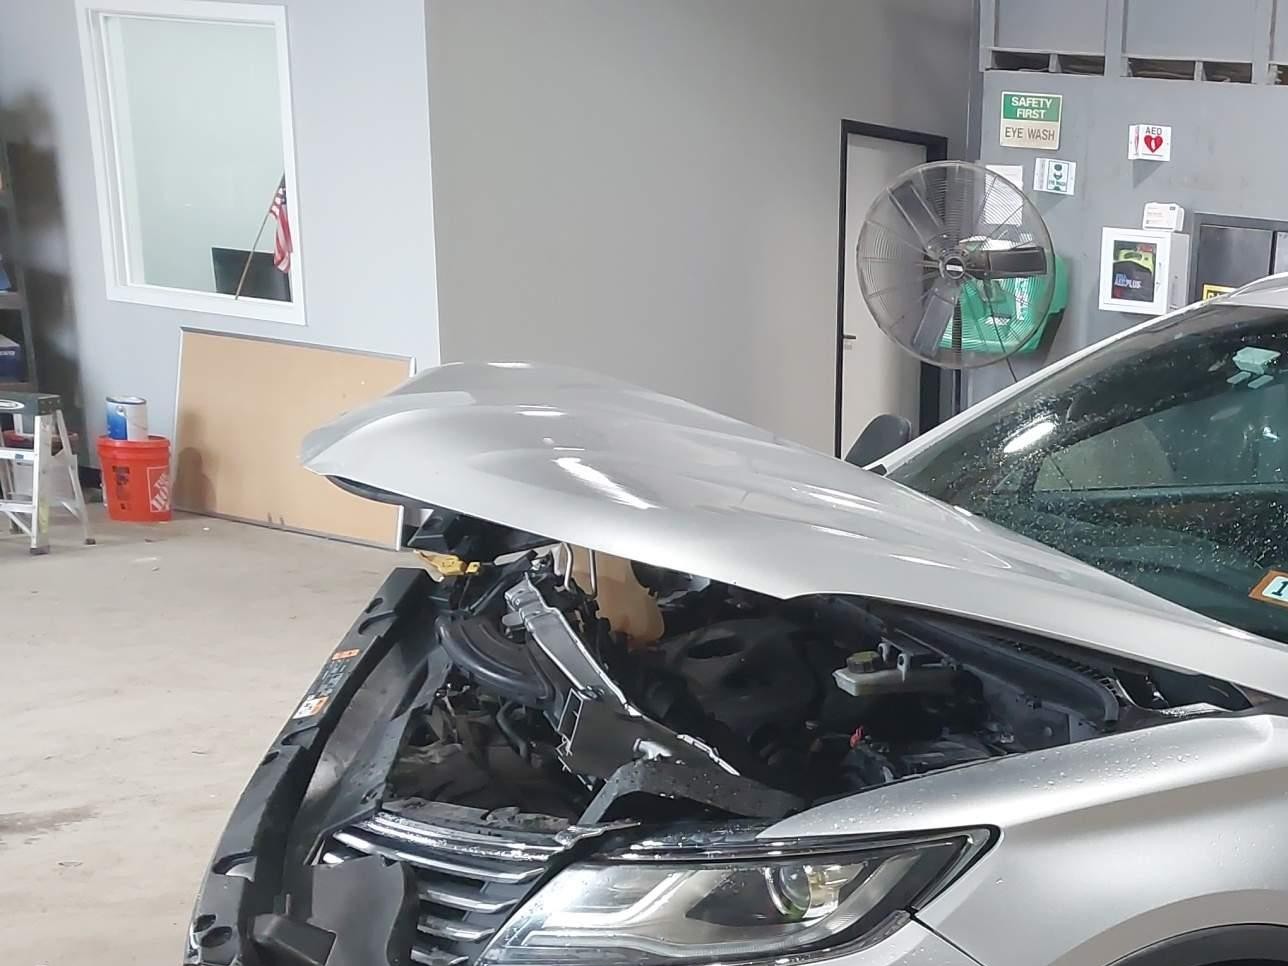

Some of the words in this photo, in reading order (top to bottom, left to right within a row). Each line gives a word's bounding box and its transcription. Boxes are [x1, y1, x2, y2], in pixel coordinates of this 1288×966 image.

[1011, 96, 1053, 108] SAFETY
[1016, 108, 1047, 119] FIRST
[1005, 127, 1024, 138] EYE
[1028, 128, 1055, 141] WASH
[1145, 126, 1162, 136] AED
